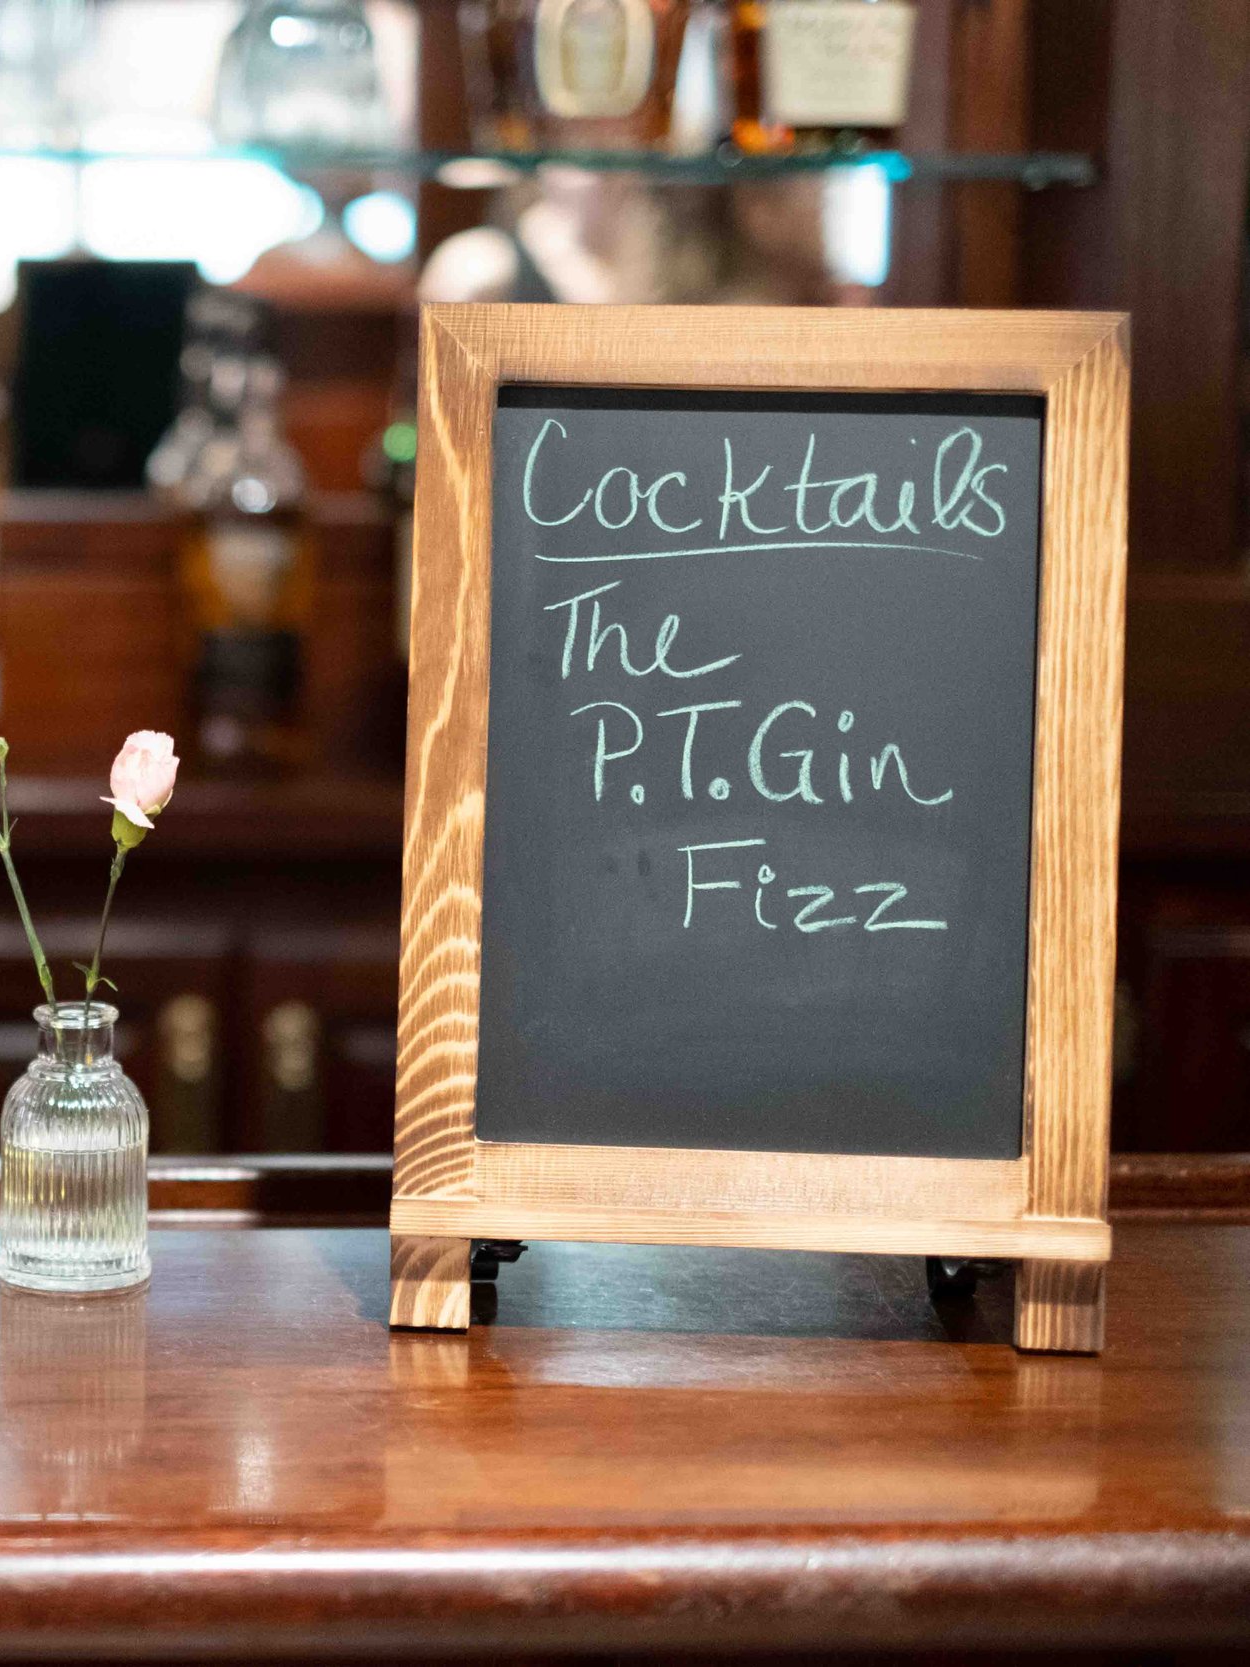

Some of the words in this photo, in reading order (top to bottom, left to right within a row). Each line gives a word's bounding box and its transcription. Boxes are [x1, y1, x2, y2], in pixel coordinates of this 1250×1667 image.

[523, 419, 1008, 541] Cocktails
[544, 580, 742, 679] The
[677, 838, 948, 933] Fizz
